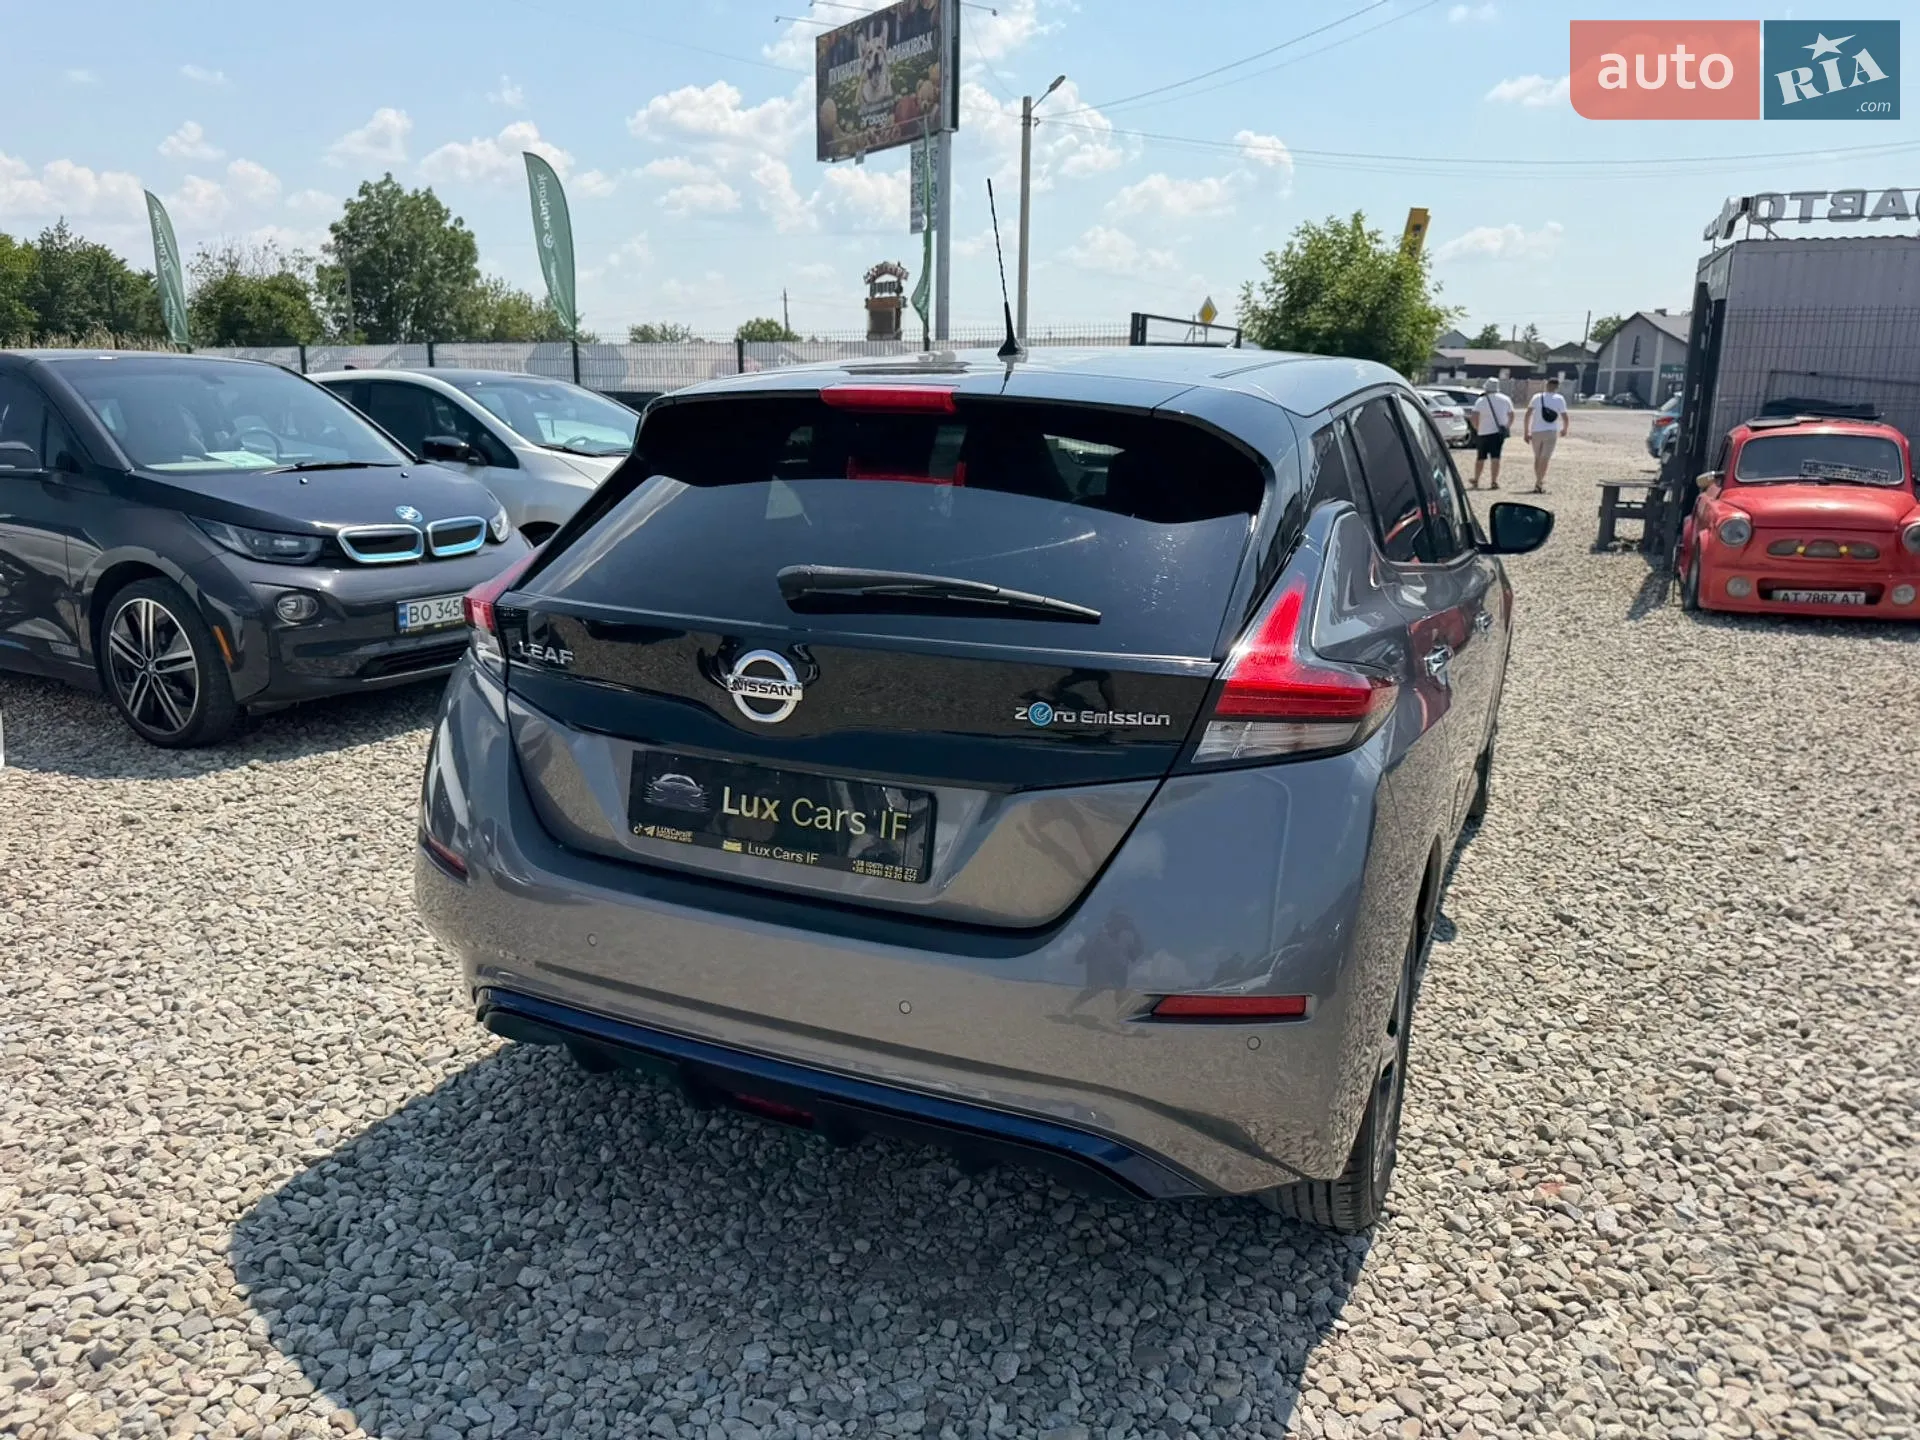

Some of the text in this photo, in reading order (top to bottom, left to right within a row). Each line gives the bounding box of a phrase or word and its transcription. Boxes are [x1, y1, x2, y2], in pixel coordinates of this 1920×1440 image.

[1782, 591, 1862, 606] AT 7887 AT
[409, 598, 465, 624] BO 345
[518, 641, 574, 664] LEAF
[730, 679, 793, 697] NISSAN
[1080, 710, 1171, 726] Emission
[722, 786, 912, 841] Lux Cars IF
[748, 842, 819, 865] Lux Cars IF
